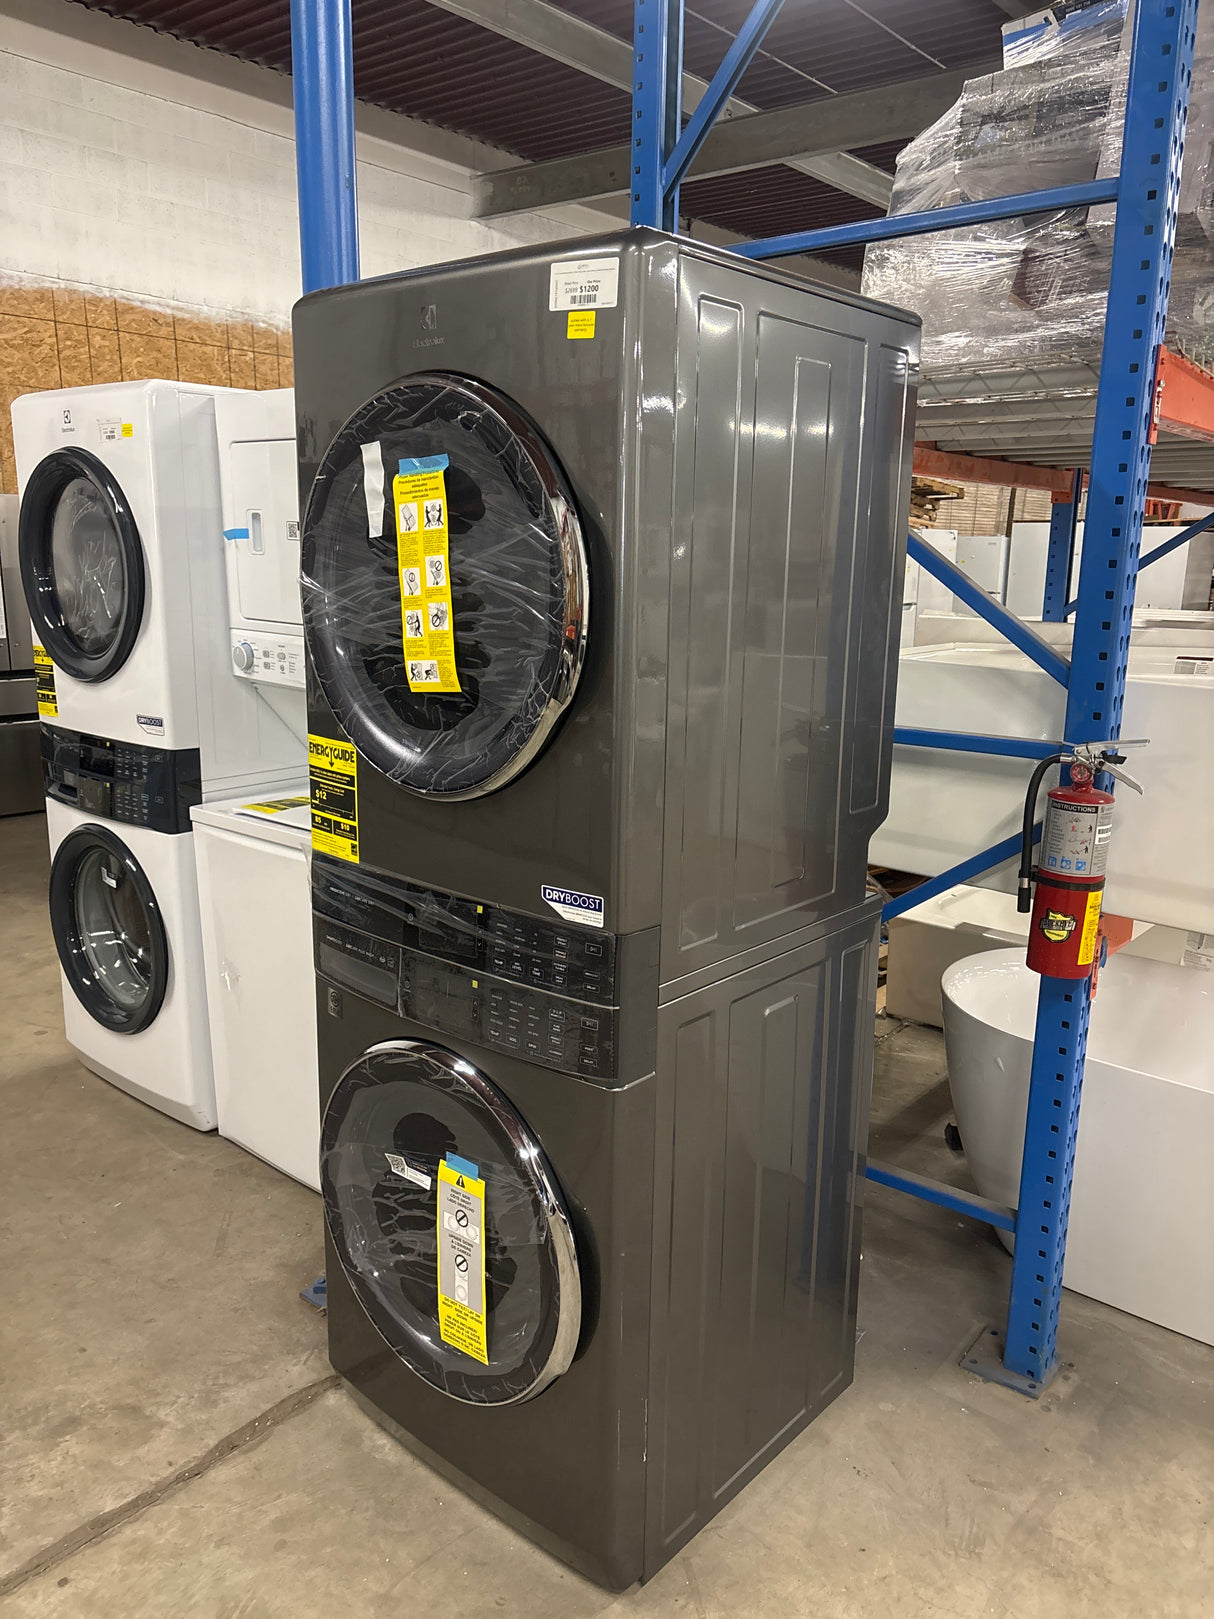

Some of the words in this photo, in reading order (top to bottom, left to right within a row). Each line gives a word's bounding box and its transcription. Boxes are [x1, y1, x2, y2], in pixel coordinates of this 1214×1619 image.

[580, 284, 599, 293] $1200
[309, 741, 355, 764] ENERGYGUIDE
[315, 789, 327, 800] $12
[1052, 801, 1096, 813] INSTRUCTIONS
[545, 889, 600, 910] DRYBOOST
